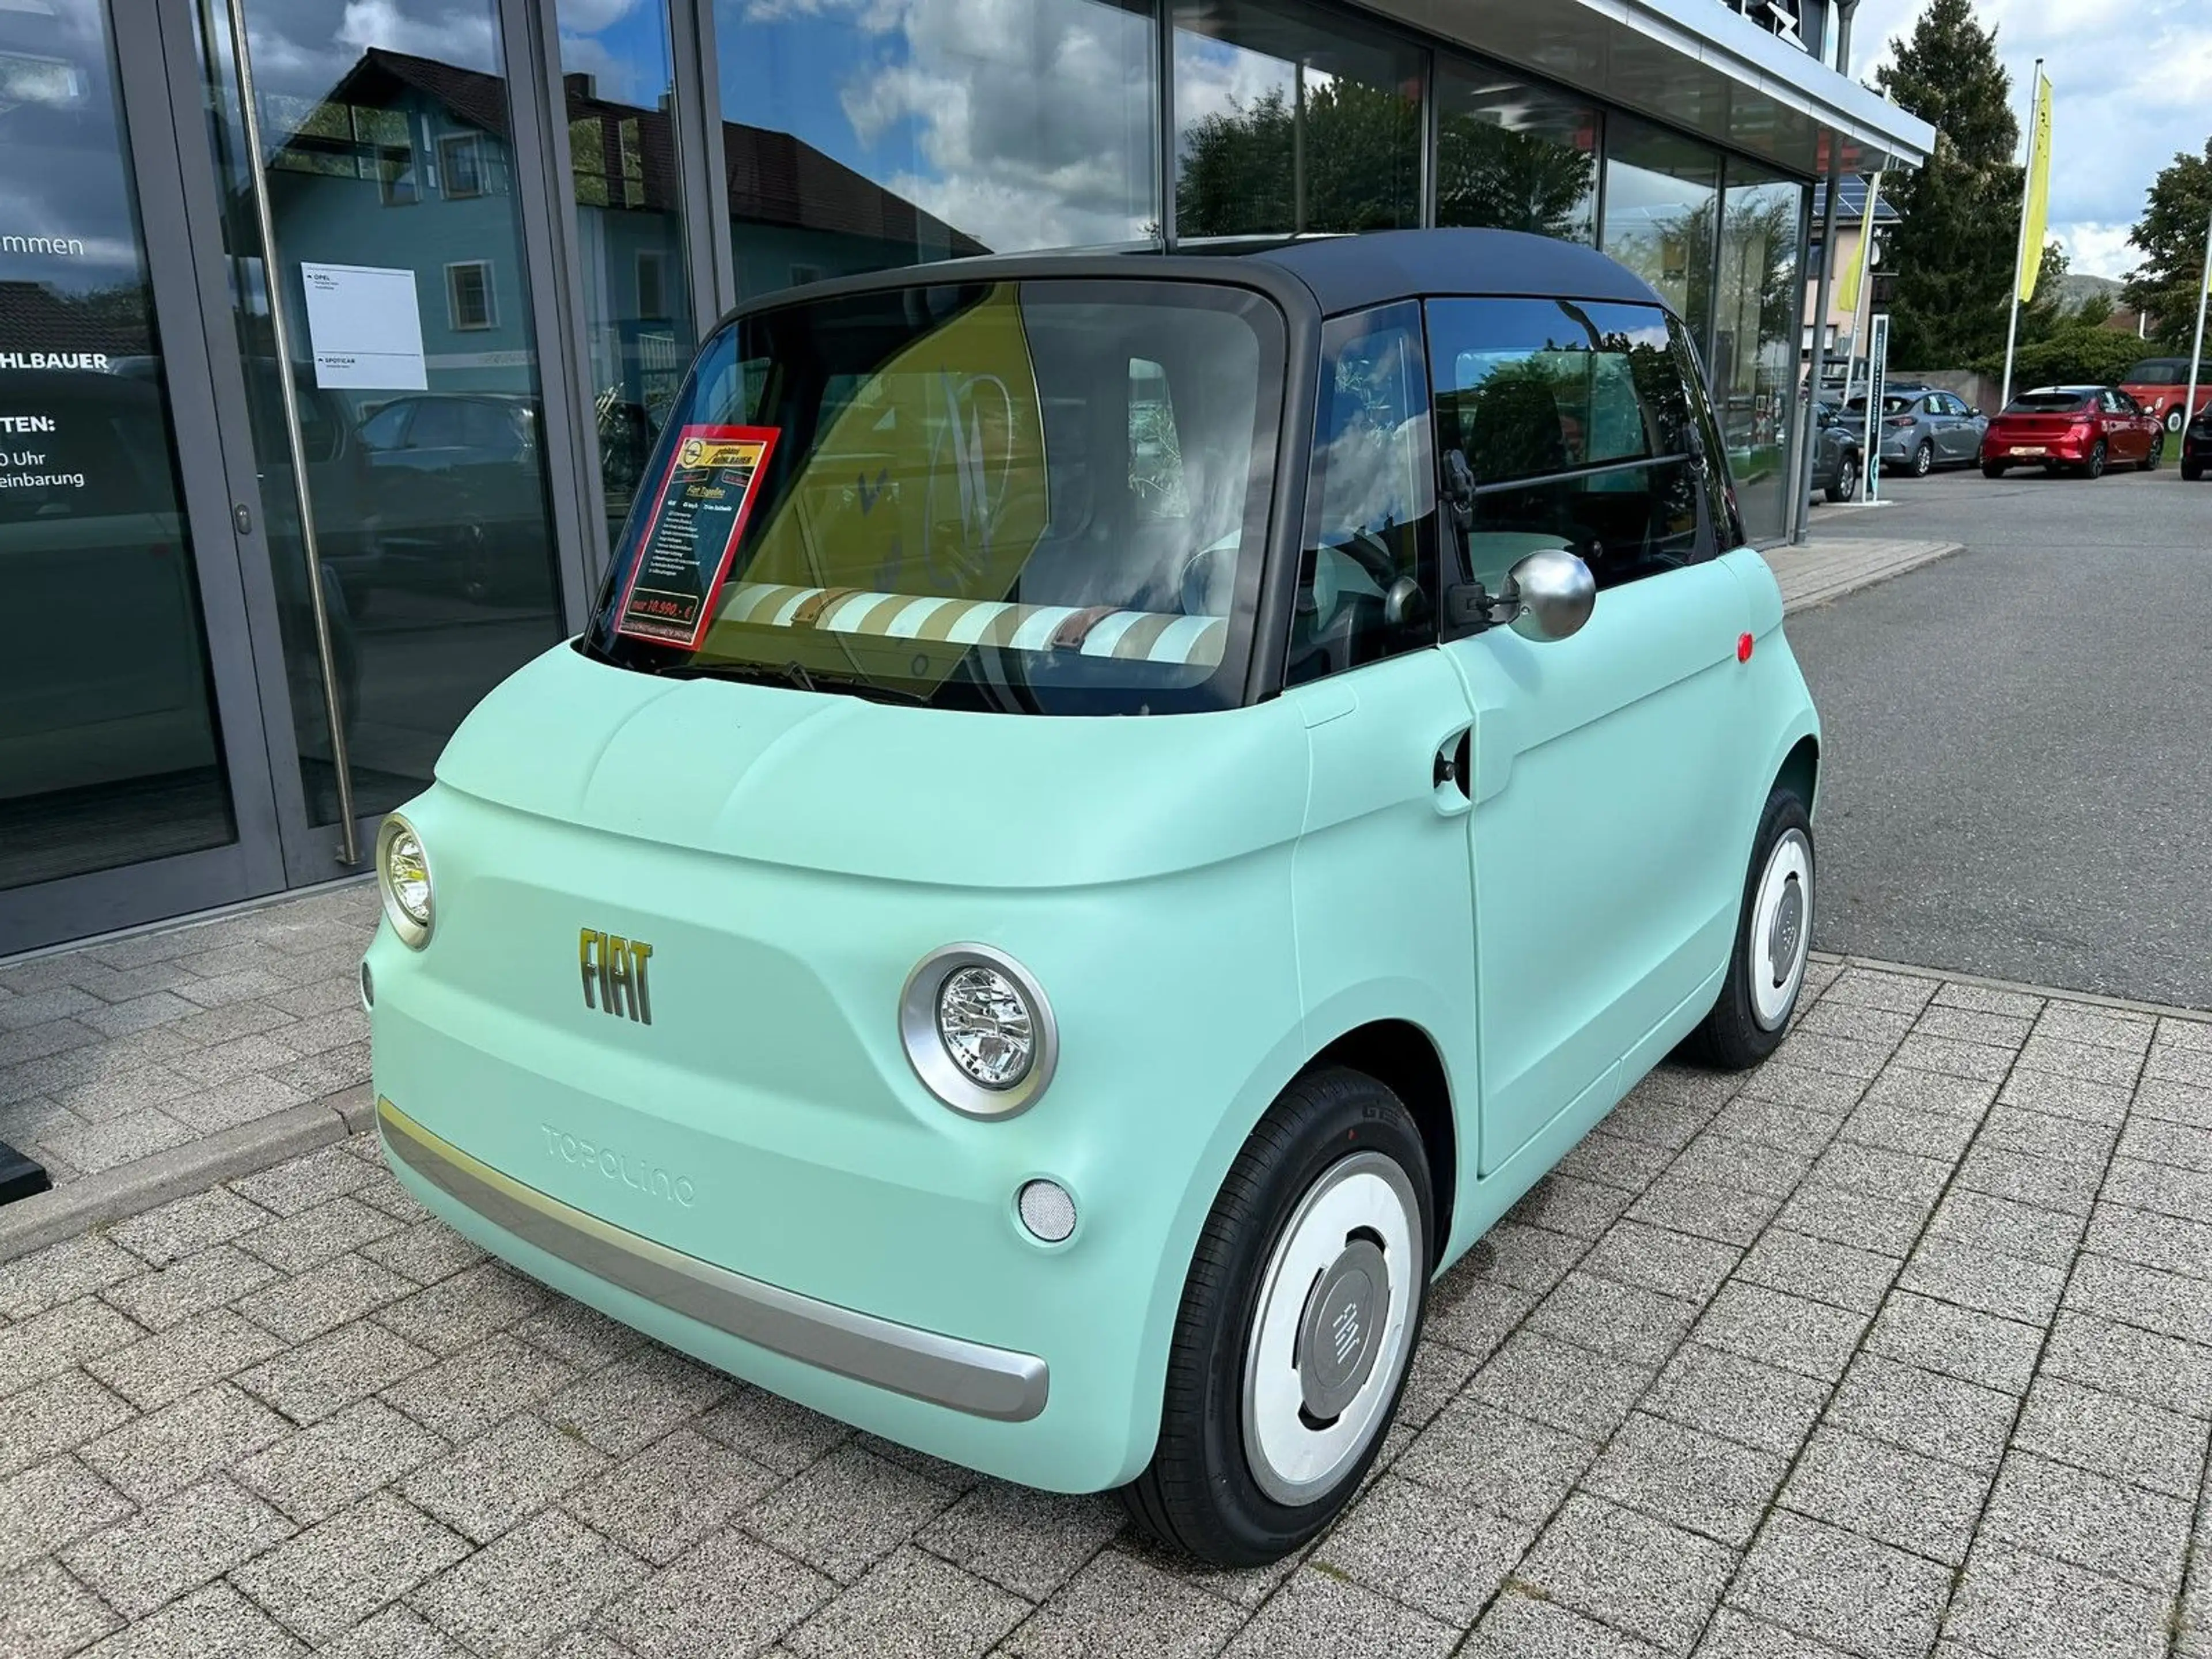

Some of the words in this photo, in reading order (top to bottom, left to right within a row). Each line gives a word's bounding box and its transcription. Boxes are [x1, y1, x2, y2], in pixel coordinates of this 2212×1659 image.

[0, 352, 110, 369] HLBAUER
[13, 450, 46, 466] Uhr
[0, 472, 85, 488] einbarung
[579, 927, 653, 1026] FIAT
